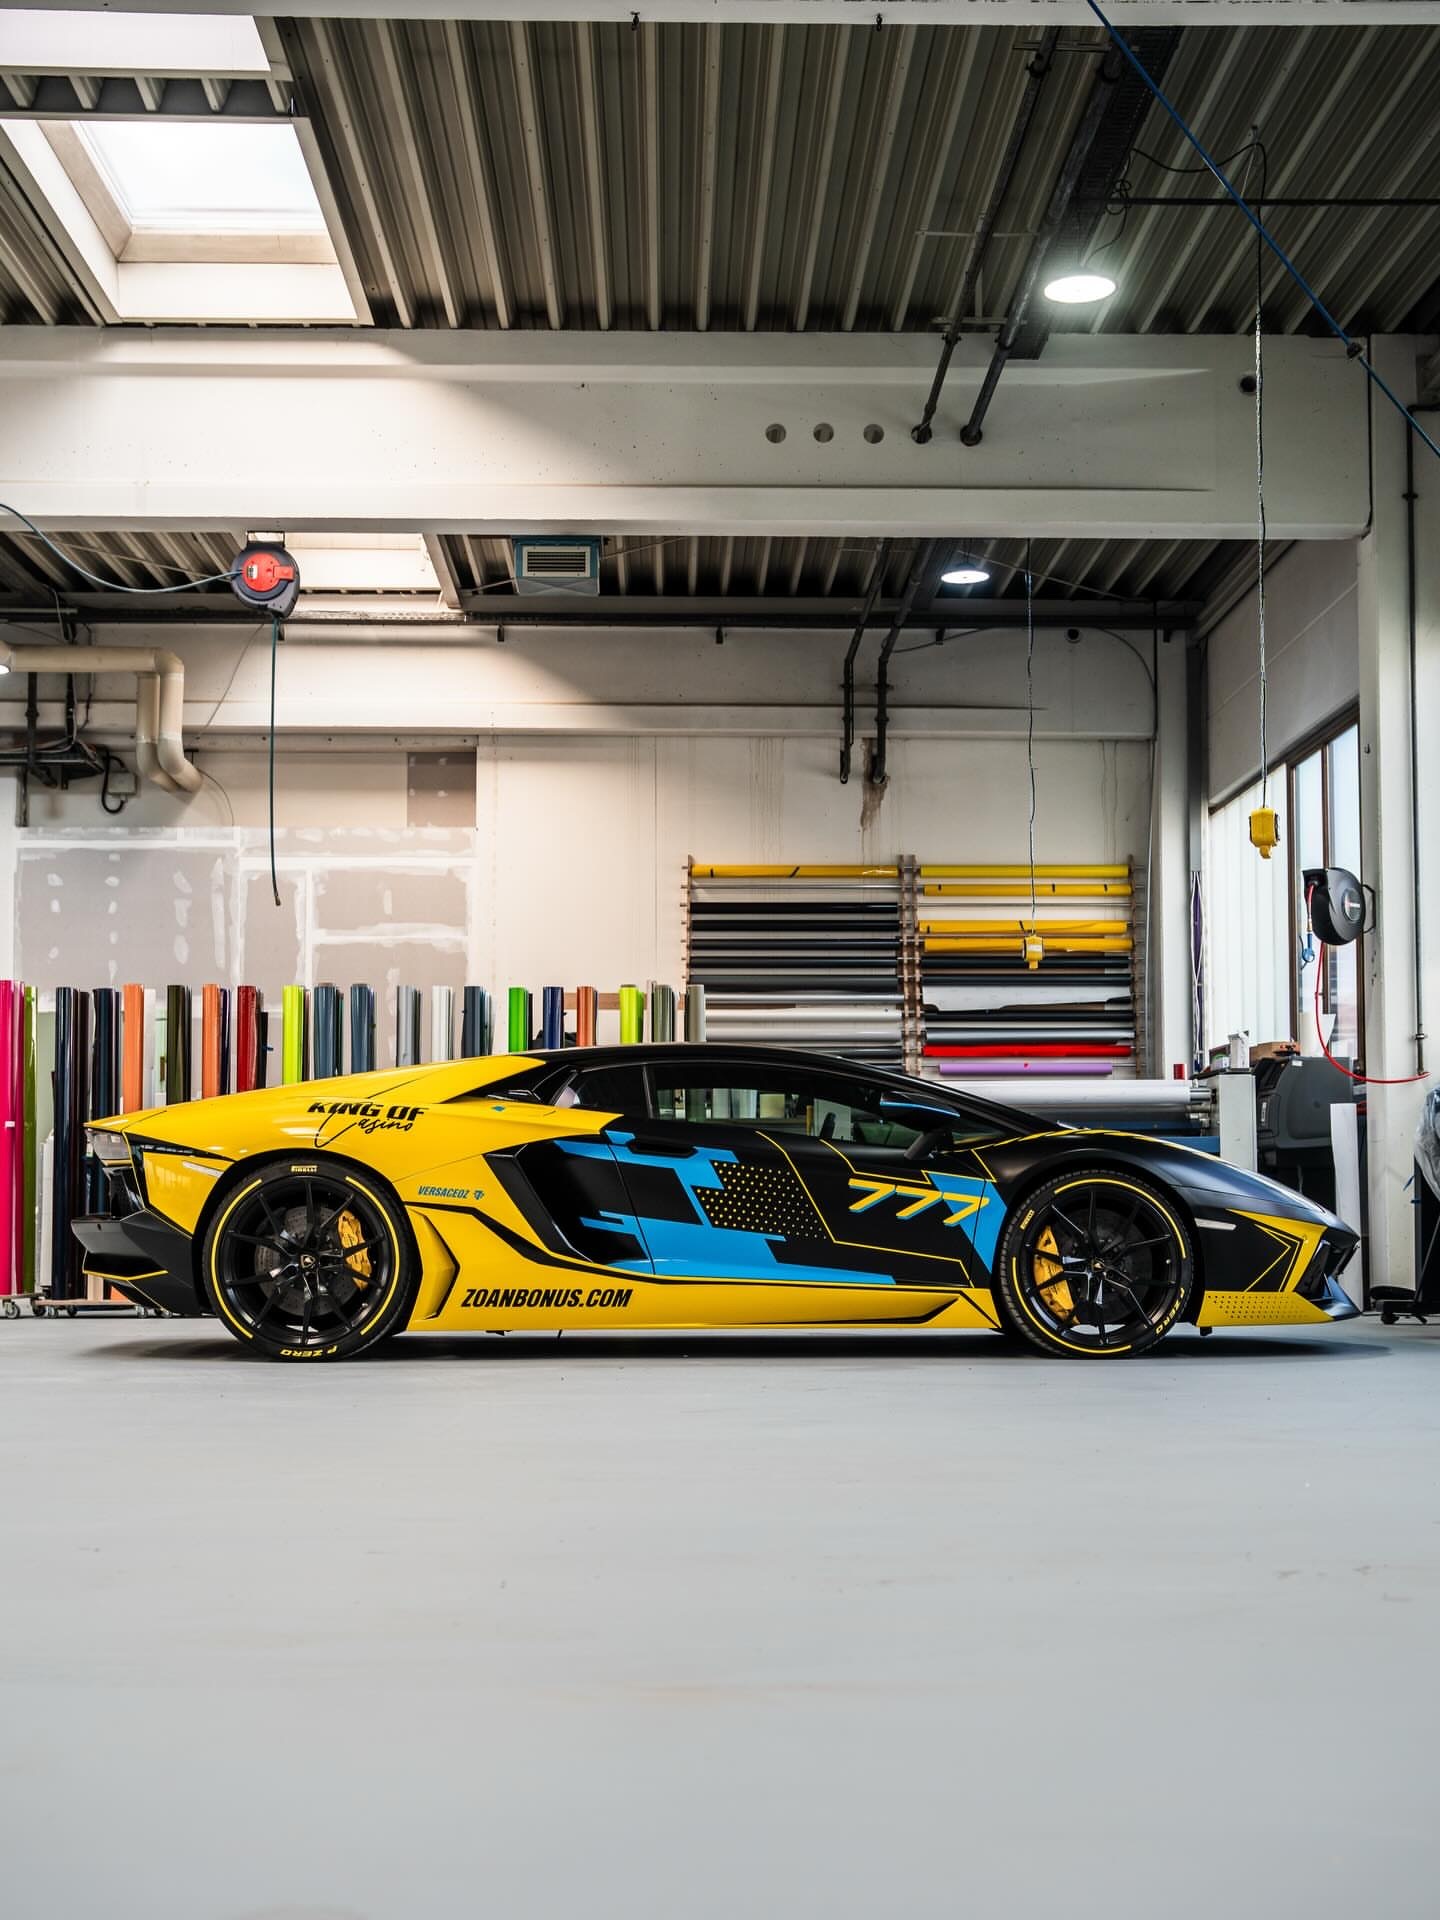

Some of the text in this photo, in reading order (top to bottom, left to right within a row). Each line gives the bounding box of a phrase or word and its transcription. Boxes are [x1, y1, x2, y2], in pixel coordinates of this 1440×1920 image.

[307, 1102, 430, 1121] KING OF
[848, 1178, 990, 1227] 777
[461, 1288, 633, 1308] ZOANBONUS.COM
